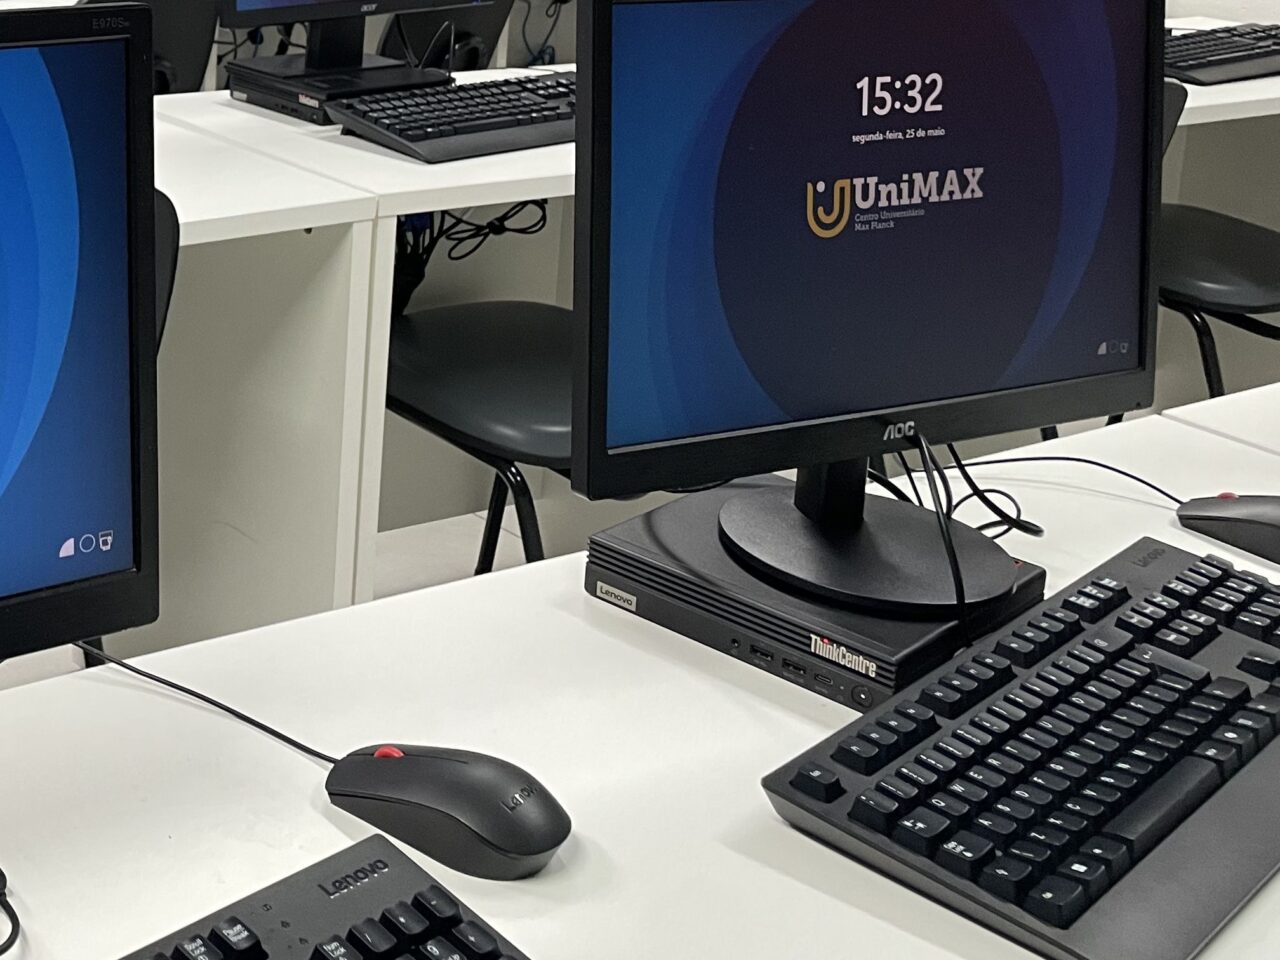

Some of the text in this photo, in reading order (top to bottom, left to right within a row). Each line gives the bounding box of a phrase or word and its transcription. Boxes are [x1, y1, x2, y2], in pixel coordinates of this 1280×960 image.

[856, 72, 943, 116] 15:32
[852, 127, 945, 144] segunda-feira, 25 de maio
[852, 167, 984, 210] UniMAX
[854, 212, 879, 222] Centro
[883, 421, 915, 440] AOC
[599, 585, 634, 606] Lenovo
[809, 634, 877, 678] ThinkCentre
[317, 858, 390, 900] Lenovo
